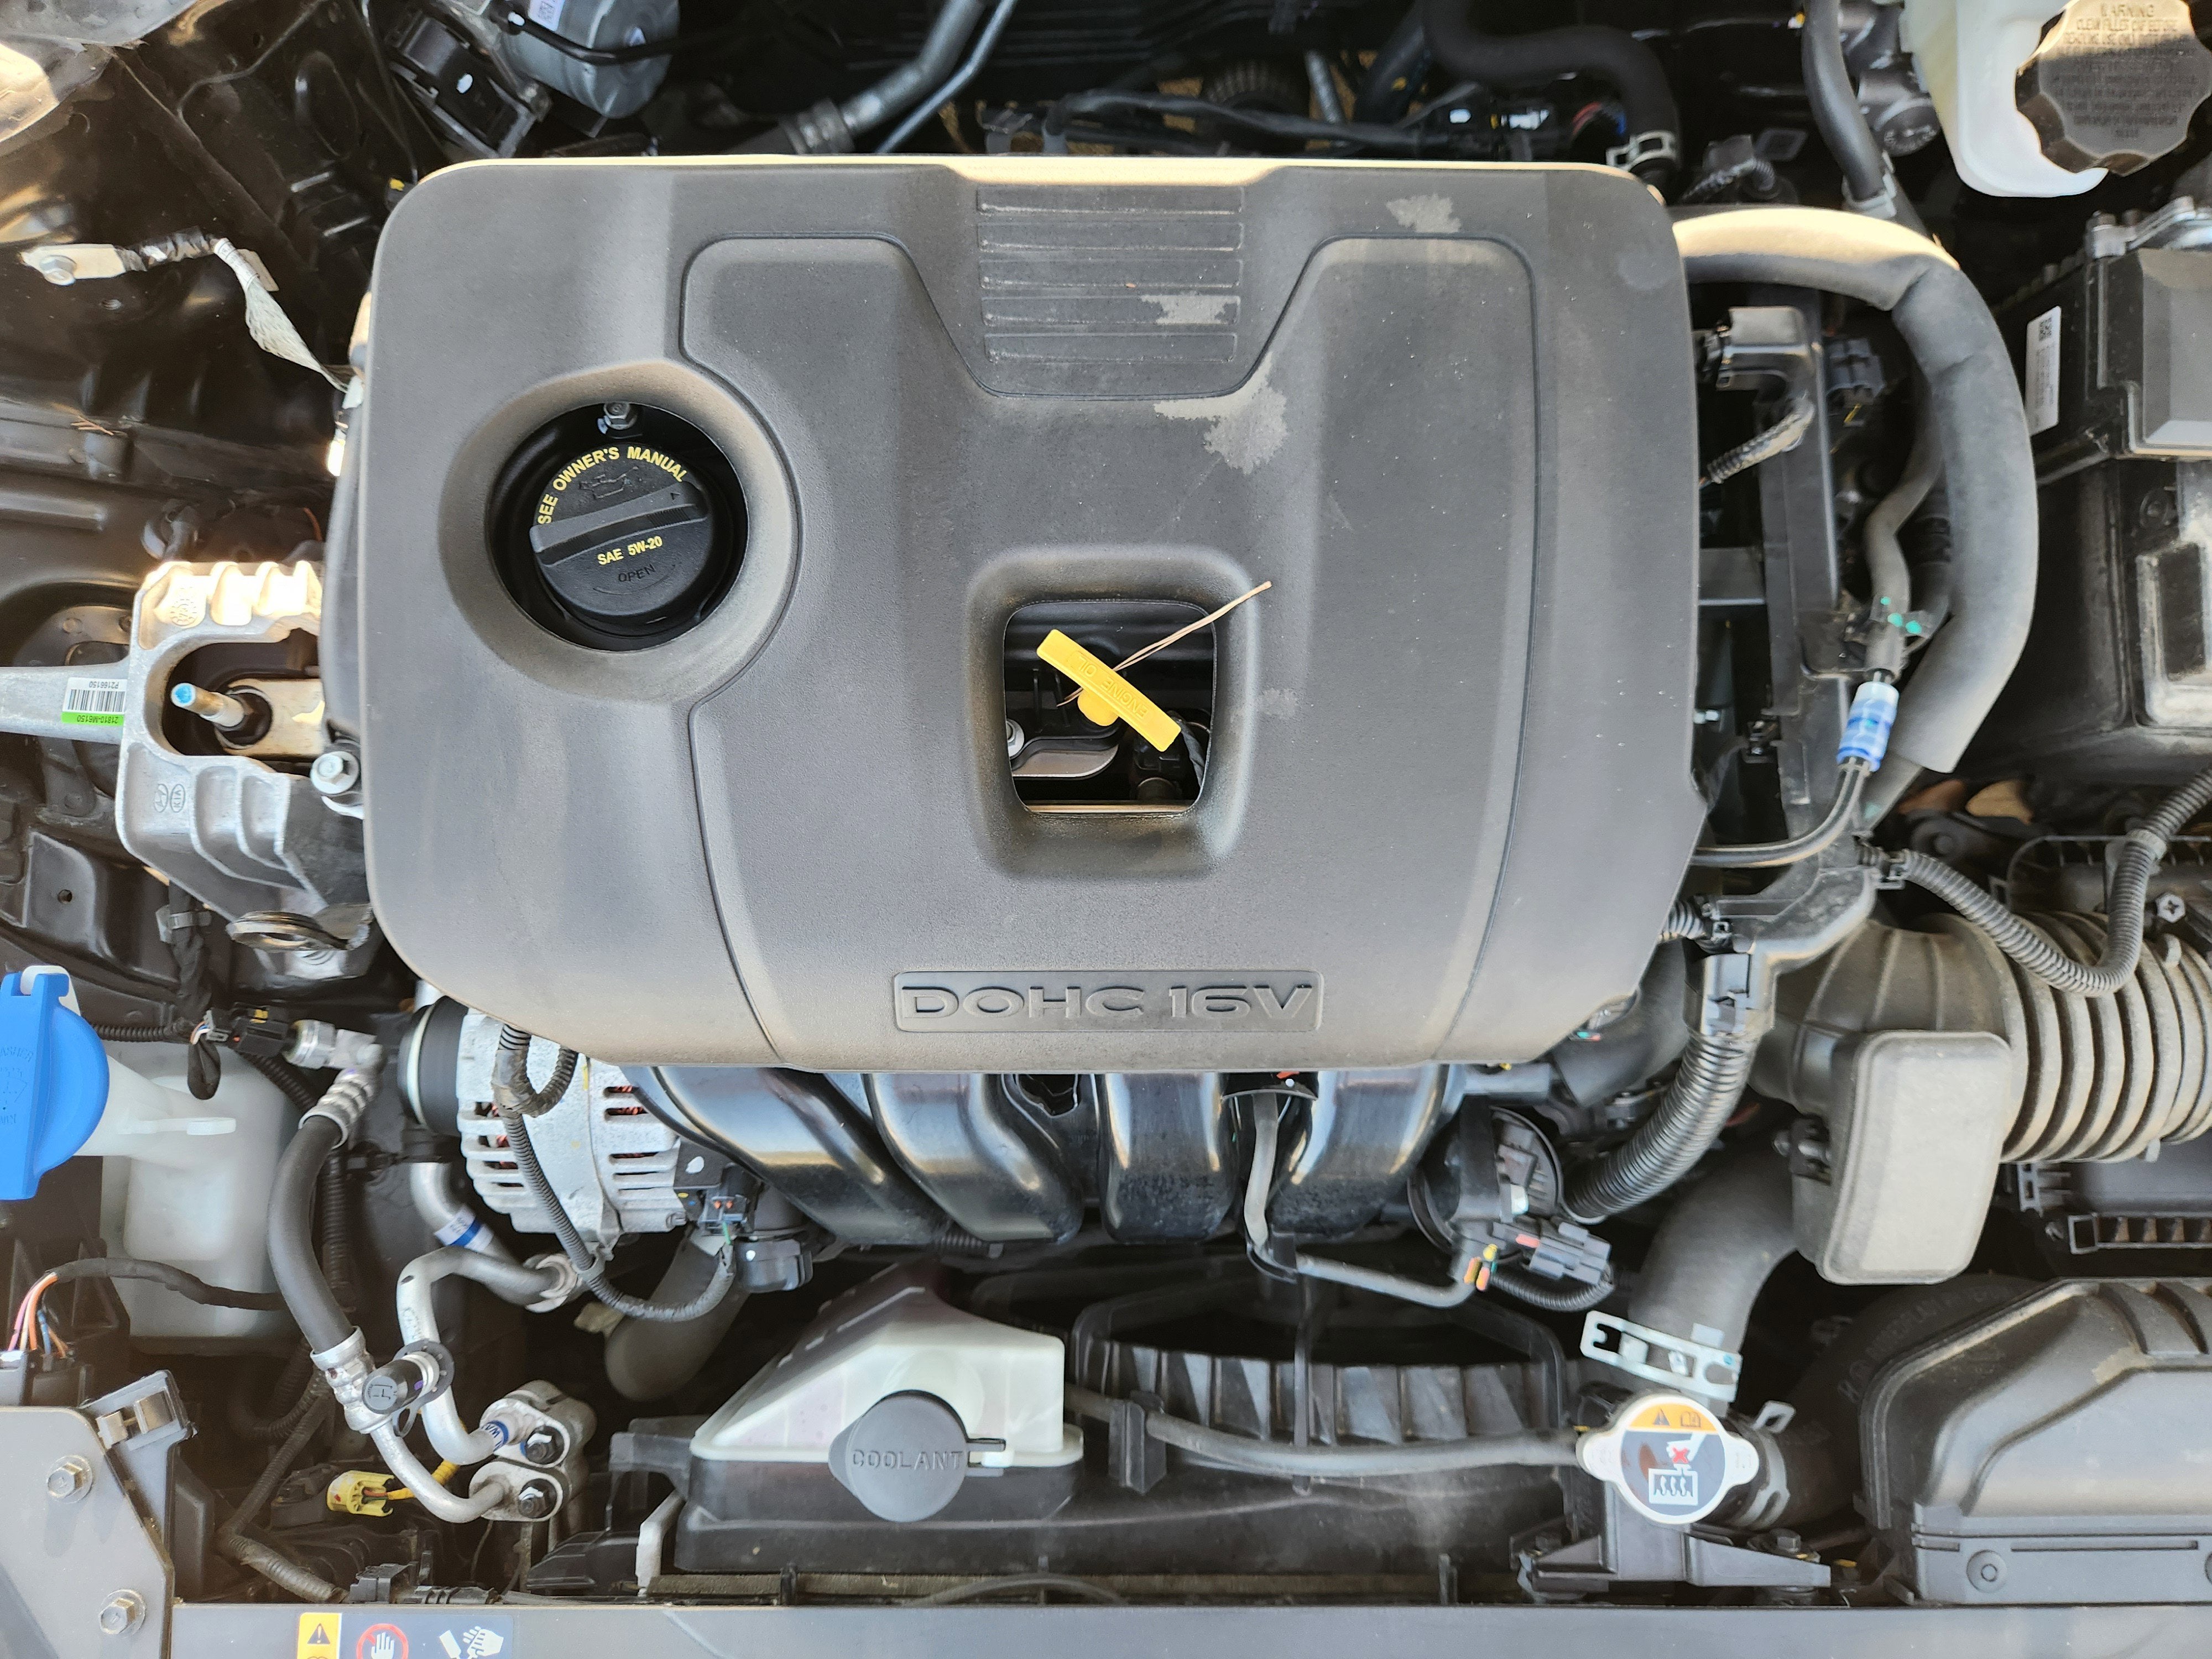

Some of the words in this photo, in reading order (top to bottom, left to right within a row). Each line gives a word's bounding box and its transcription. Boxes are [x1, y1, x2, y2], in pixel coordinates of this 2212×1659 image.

[538, 493, 559, 525] SEE
[552, 446, 620, 492] OWNER'S
[627, 446, 688, 483] MANUAL
[597, 548, 625, 566] SAE
[627, 535, 664, 557] 5W-20
[617, 564, 656, 583] OPEN
[1077, 655, 1098, 678] OIL
[1100, 676, 1150, 718] ENGINE
[901, 985, 1145, 1020] DOHC
[1167, 984, 1314, 1020] 16V
[0, 1046, 34, 1063] ASHER
[852, 1449, 963, 1470] COOLANT
